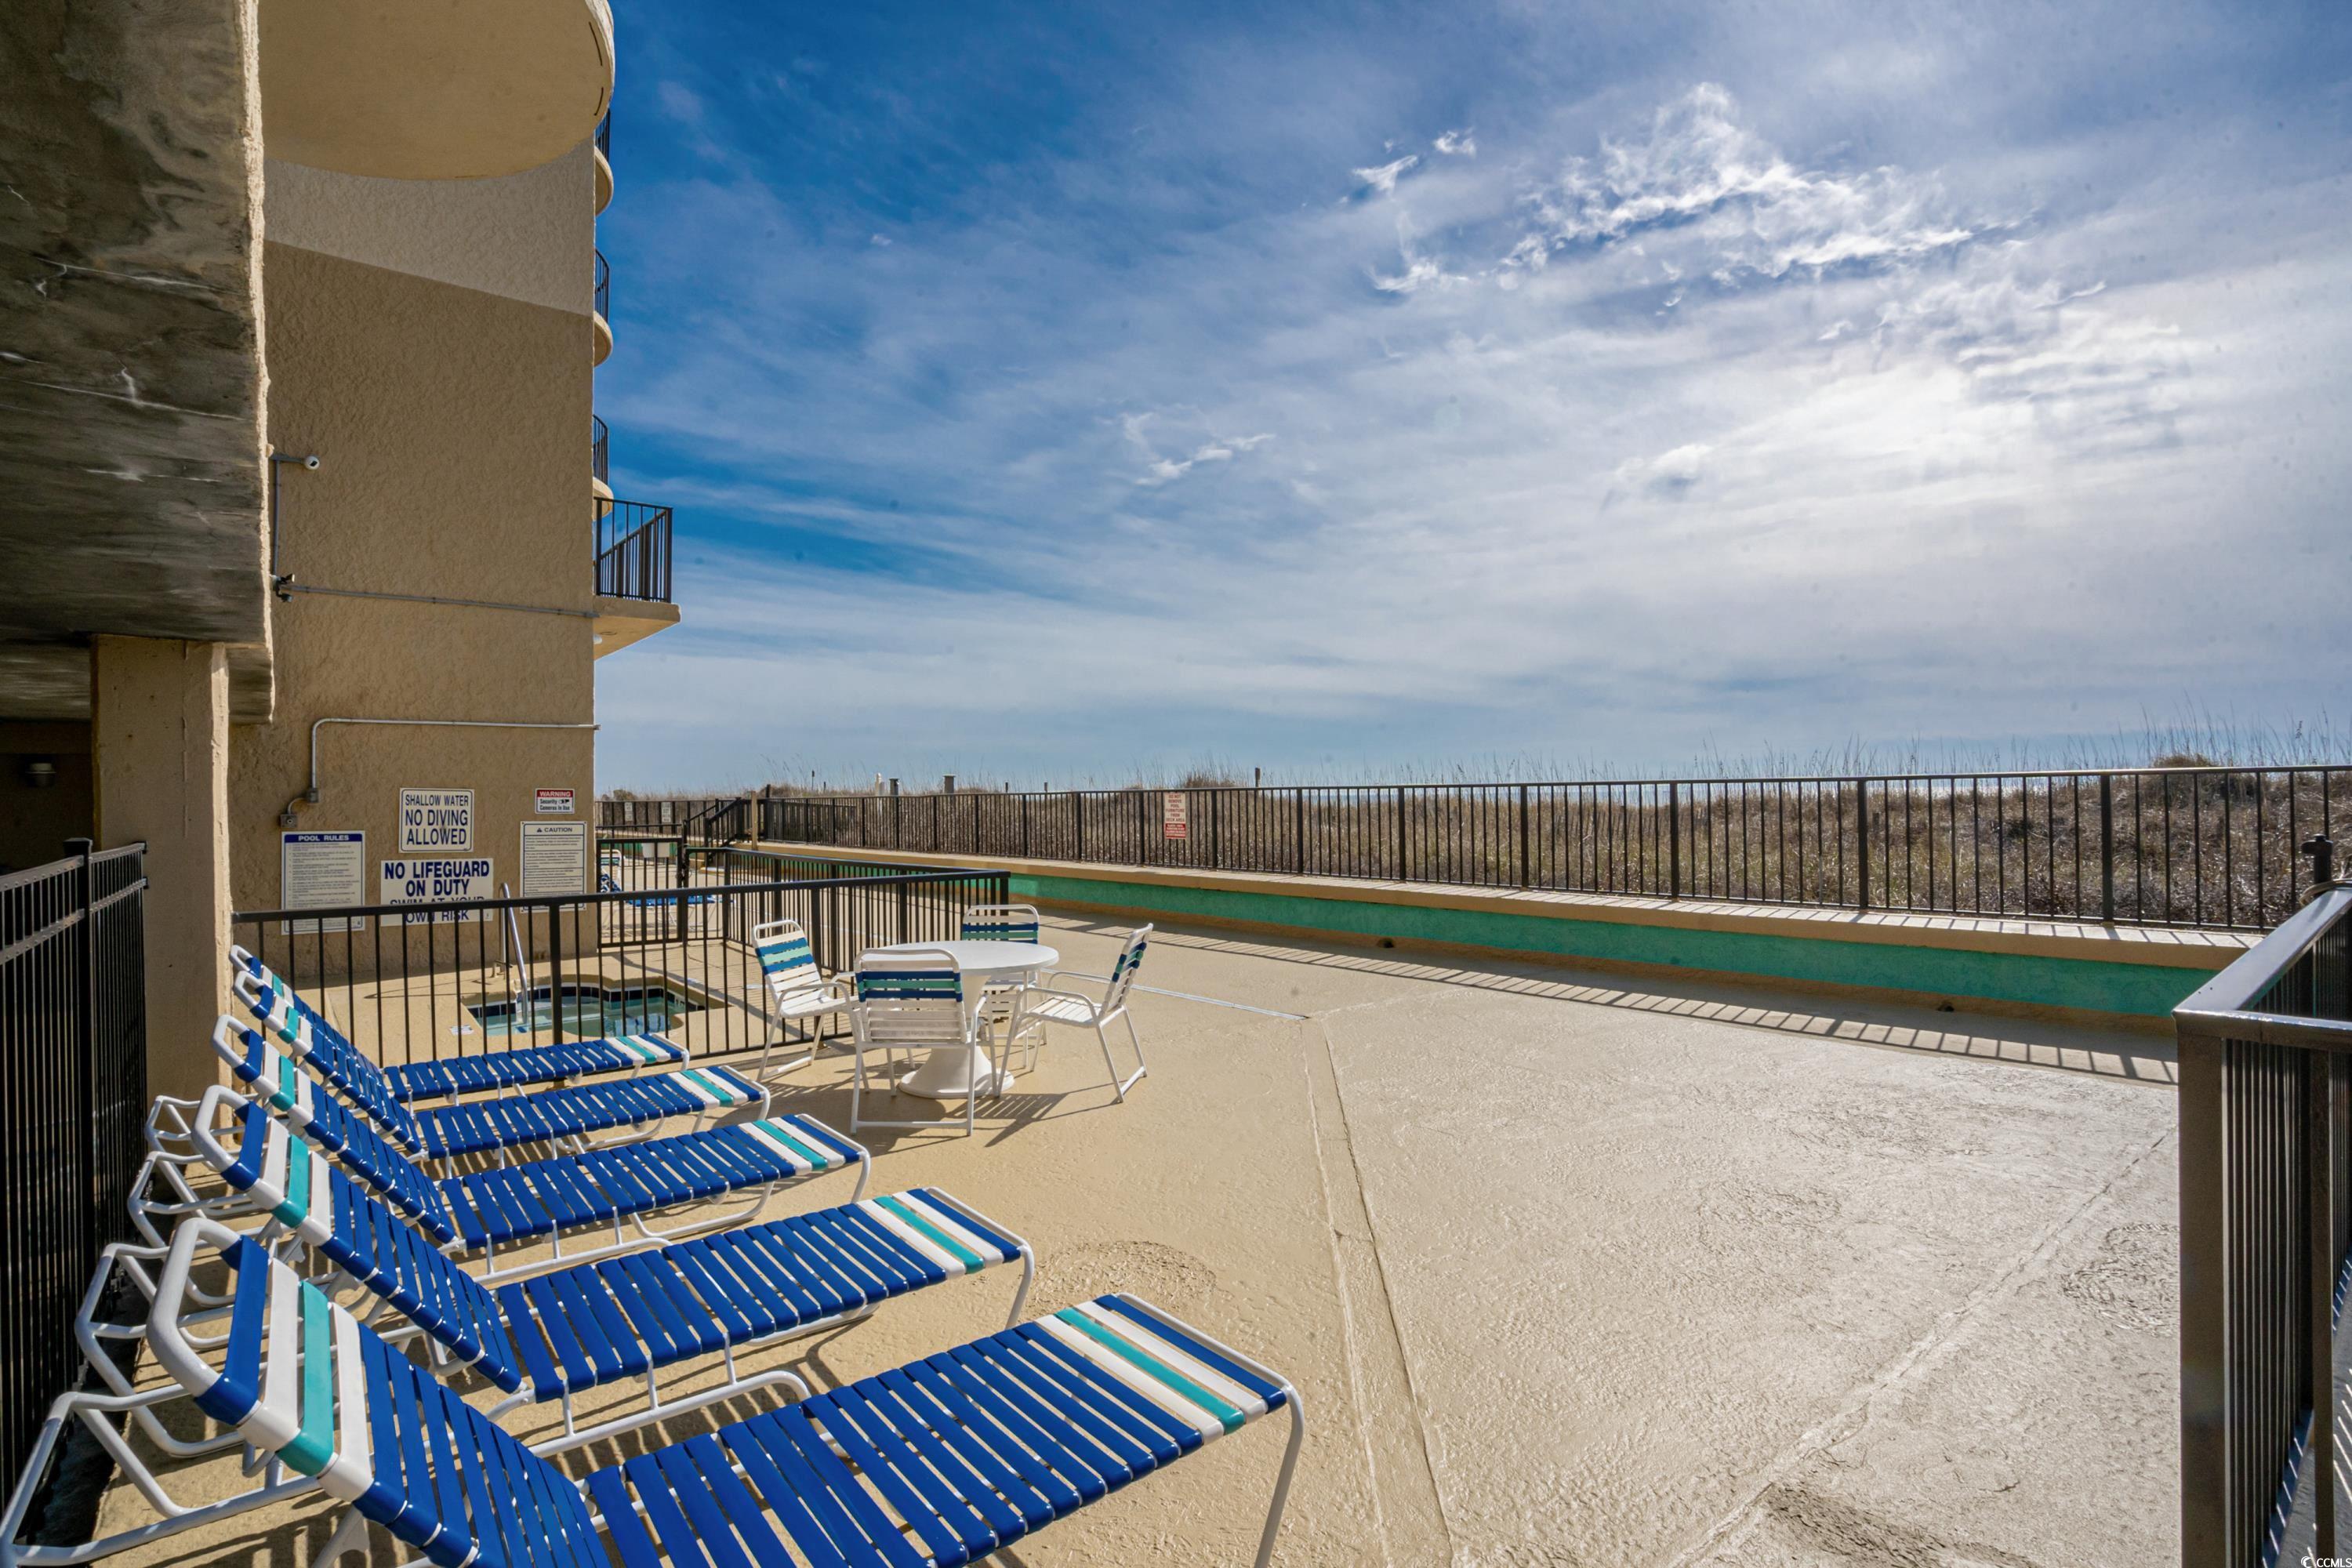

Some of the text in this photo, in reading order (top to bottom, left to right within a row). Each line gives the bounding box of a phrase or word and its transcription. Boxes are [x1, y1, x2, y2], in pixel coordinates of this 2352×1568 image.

[405, 794, 469, 807] SHALLOW WATER
[405, 809, 468, 826] NO DIVING
[406, 828, 466, 845] ALLOWED
[384, 861, 490, 879] NO LIFEGUARD
[406, 878, 470, 897] ON DUTY
